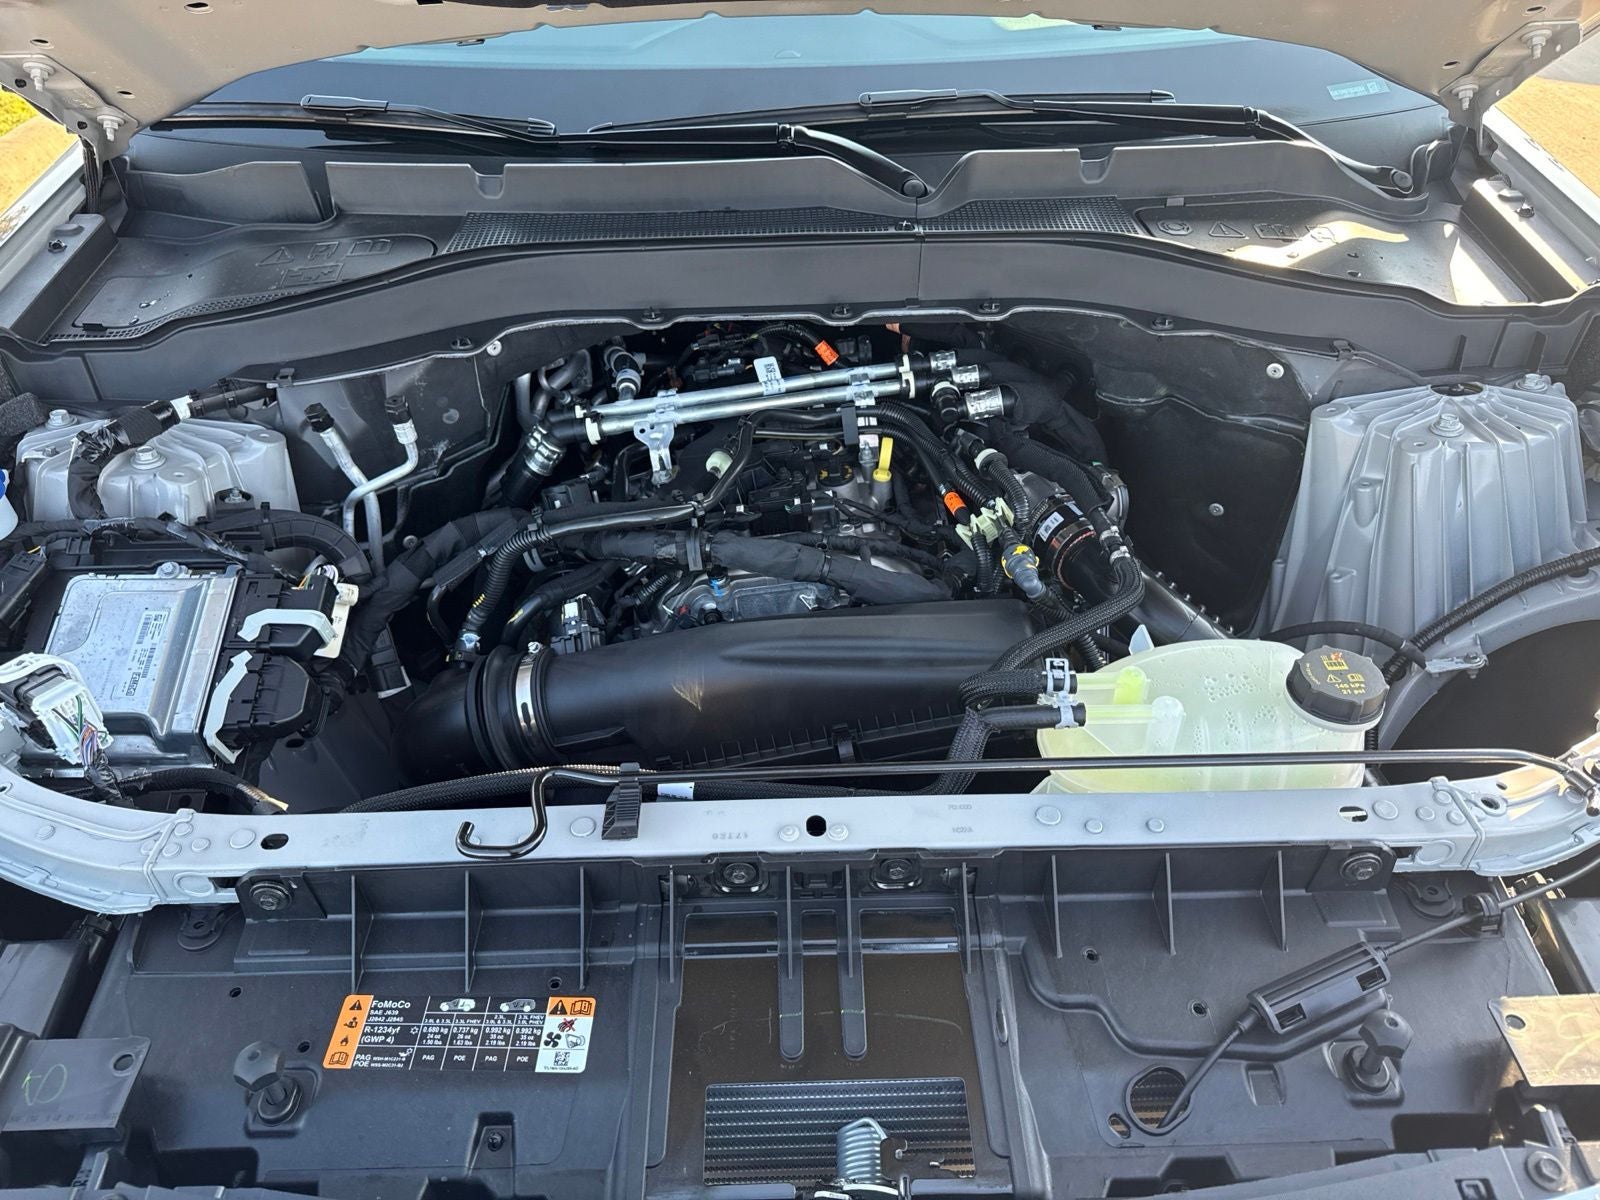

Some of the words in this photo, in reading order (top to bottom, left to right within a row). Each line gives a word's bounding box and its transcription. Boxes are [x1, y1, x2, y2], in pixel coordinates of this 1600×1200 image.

[371, 1000, 411, 1009] FoMoCo
[364, 1026, 401, 1035] R-1234yf
[440, 1026, 449, 1035] kg
[470, 1026, 479, 1035] kg
[485, 1026, 503, 1034] 0.992
[503, 1027, 511, 1035] kg
[533, 1027, 542, 1035] kg
[360, 1035, 385, 1044] (GWP
[386, 1035, 395, 1044] 4)
